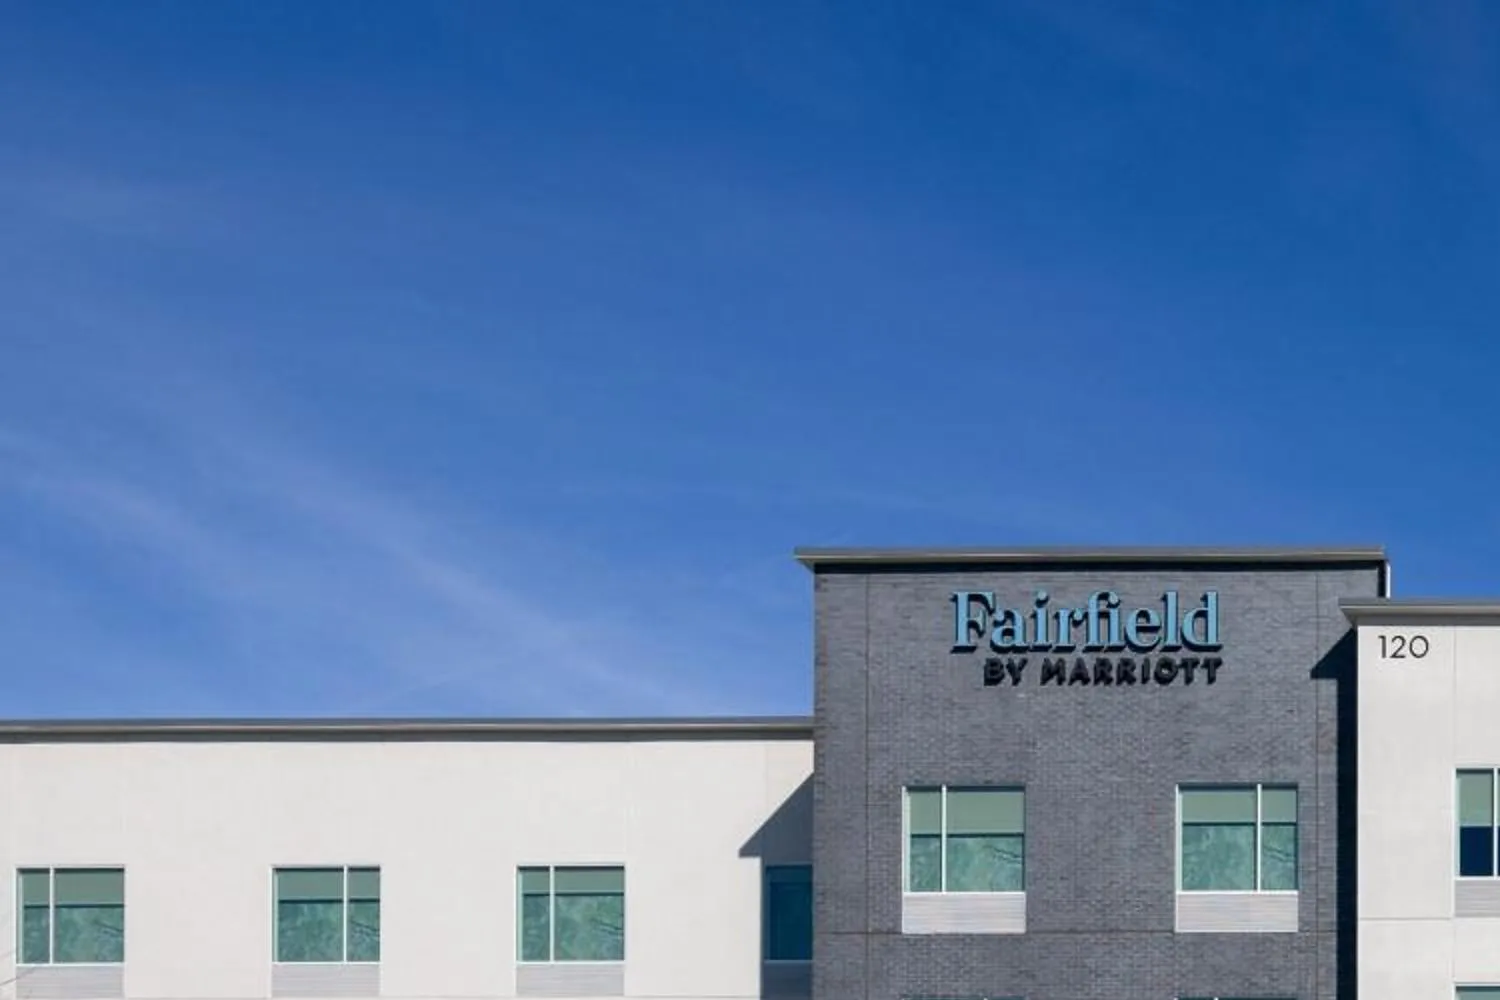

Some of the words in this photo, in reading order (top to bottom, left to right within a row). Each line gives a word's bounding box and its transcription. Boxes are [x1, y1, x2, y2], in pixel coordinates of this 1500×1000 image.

[950, 589, 1223, 653] Fairfield
[1378, 635, 1429, 659] 120
[983, 658, 1025, 686] BY
[1039, 657, 1223, 686] MARRIOTT
